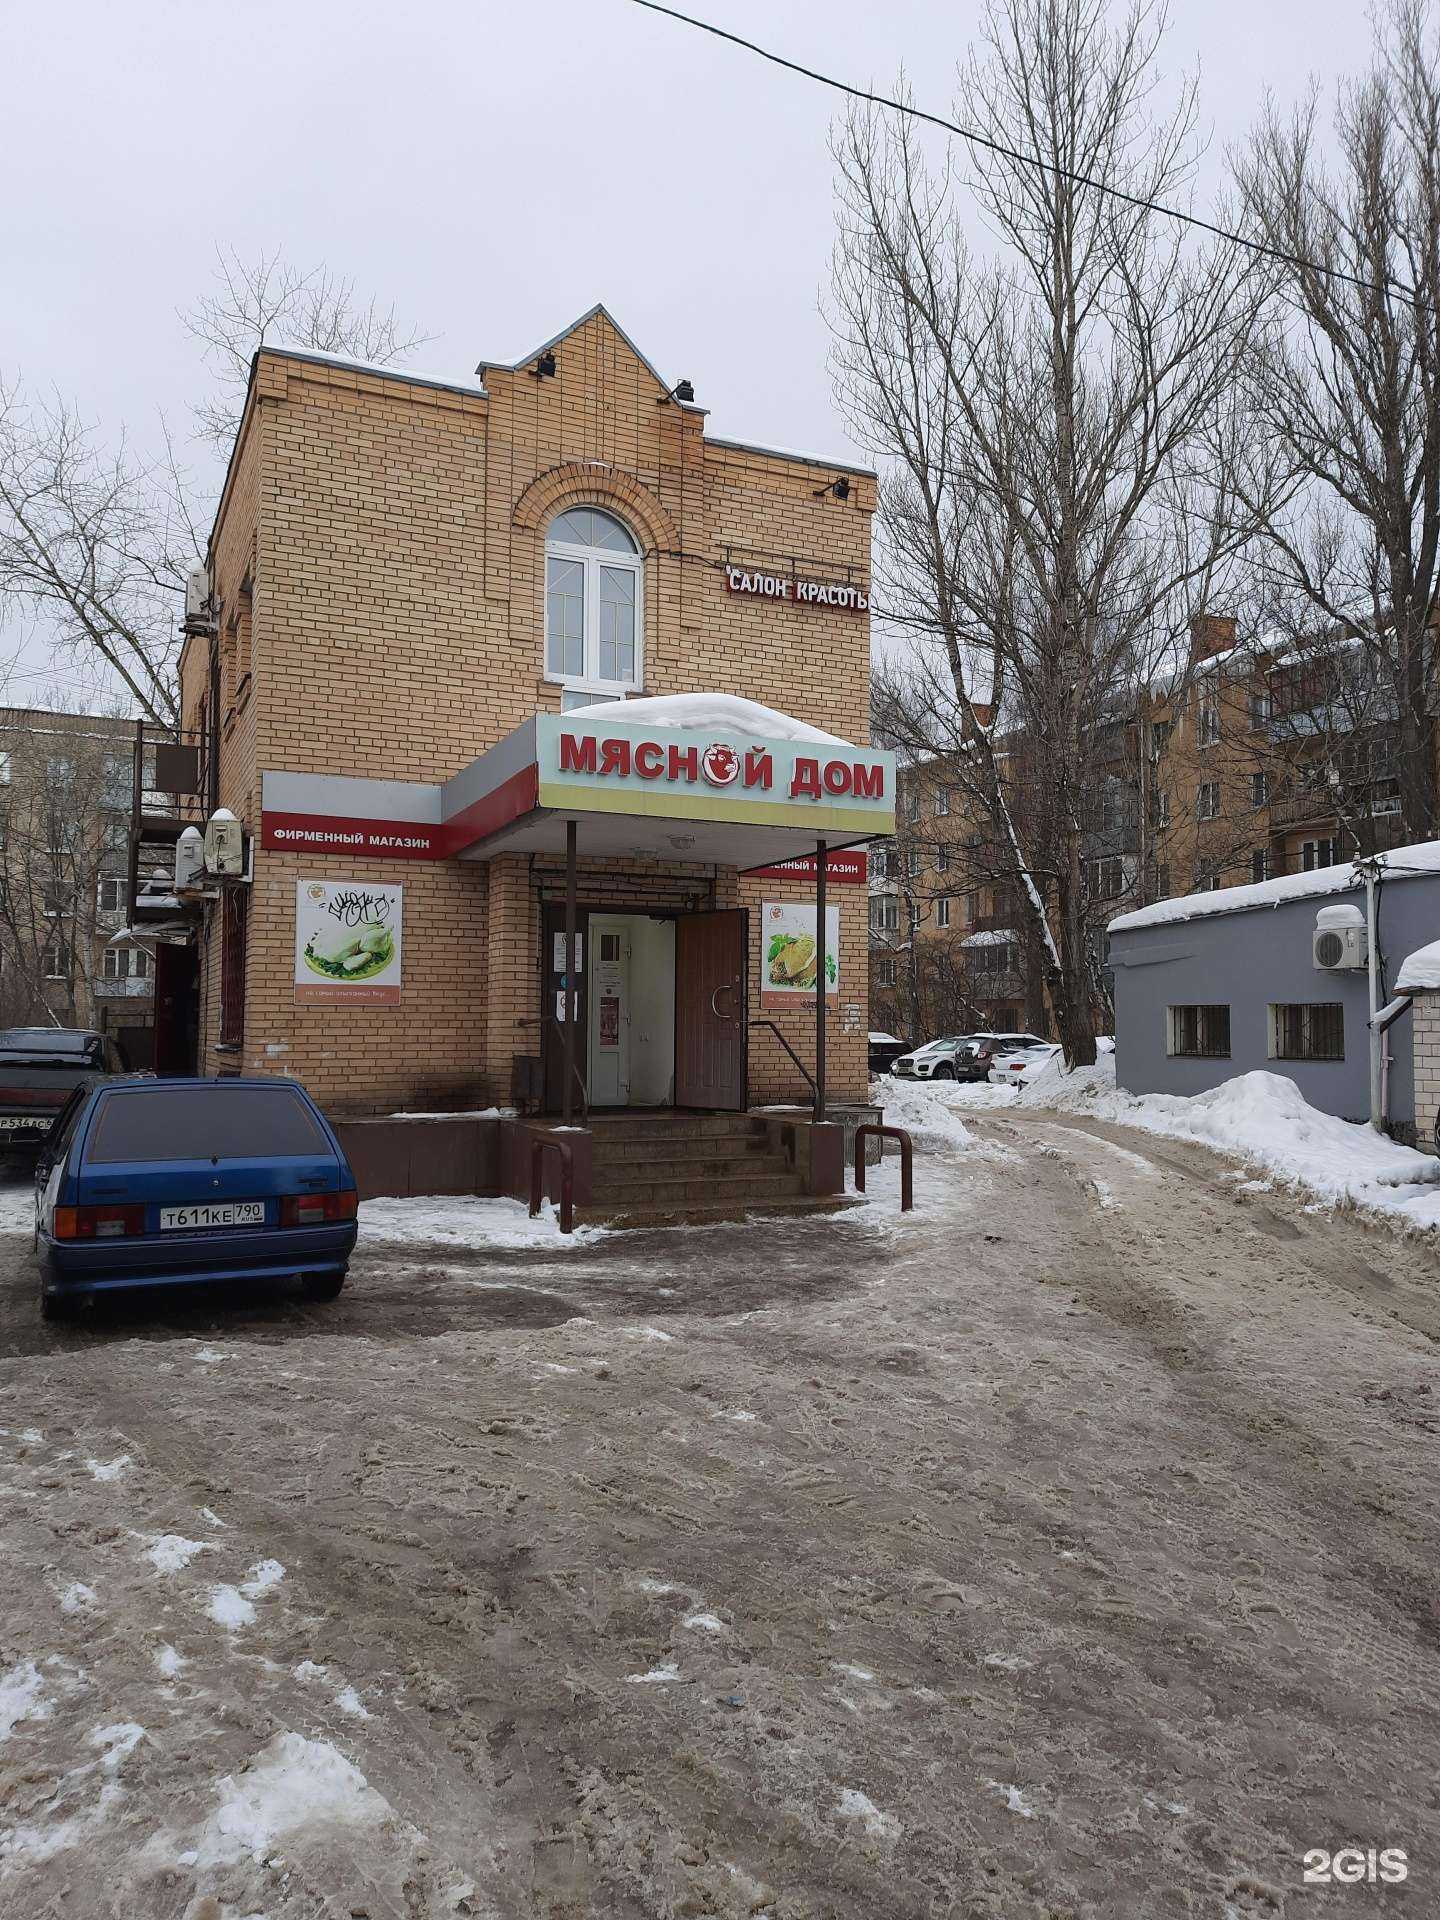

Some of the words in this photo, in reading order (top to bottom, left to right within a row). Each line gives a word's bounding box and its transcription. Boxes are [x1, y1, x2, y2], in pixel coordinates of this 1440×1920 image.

[729, 569, 787, 598] САЛОН
[797, 581, 871, 609] КРАСОТЫ
[559, 733, 773, 788] МЯСНОЙ
[789, 757, 885, 800] ДОМ
[273, 829, 364, 844] ФИРМЕННЫЙ
[369, 835, 430, 849] МАГАЗИН
